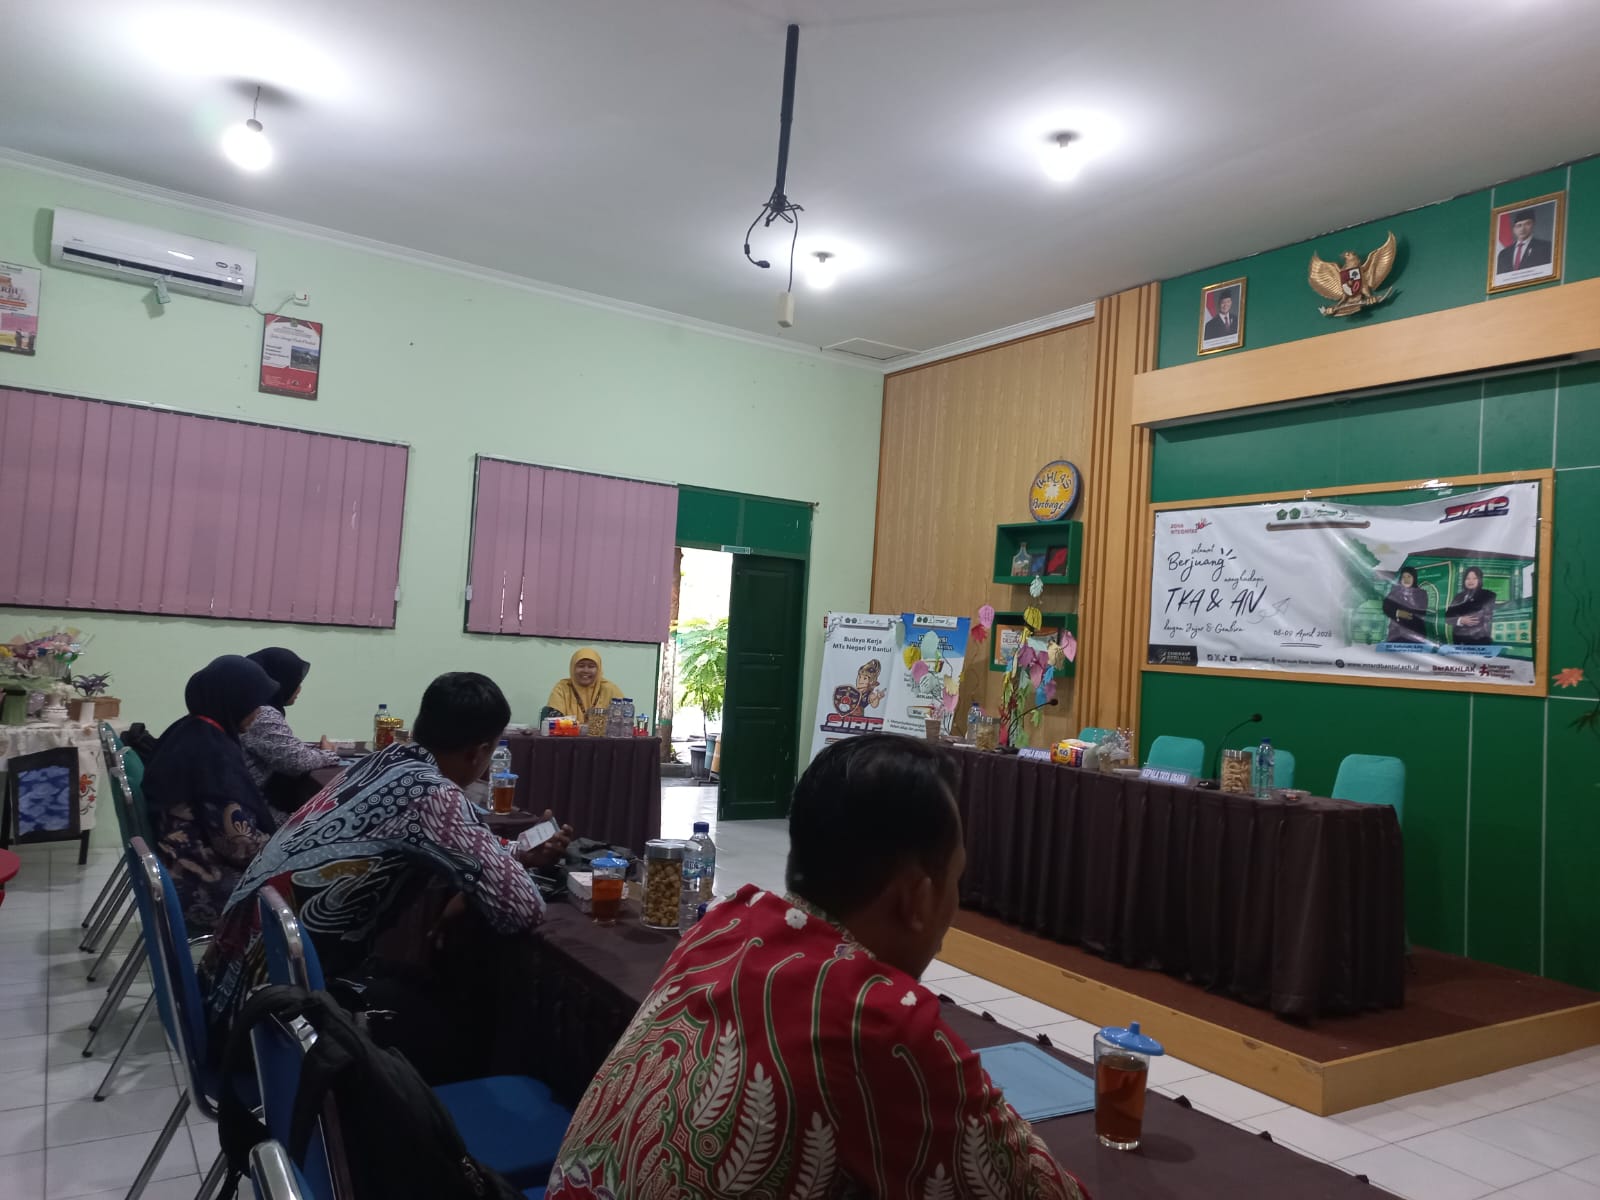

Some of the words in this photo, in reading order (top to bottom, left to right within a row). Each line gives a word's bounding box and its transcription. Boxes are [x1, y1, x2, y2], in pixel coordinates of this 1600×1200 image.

[1168, 552, 1225, 582] Berjuang
[1165, 587, 1206, 616] TKA
[1206, 588, 1223, 612] &
[1230, 585, 1267, 617] AN
[843, 636, 866, 644] Budaya
[866, 638, 882, 646] Kerja
[1295, 627, 1316, 642] April
